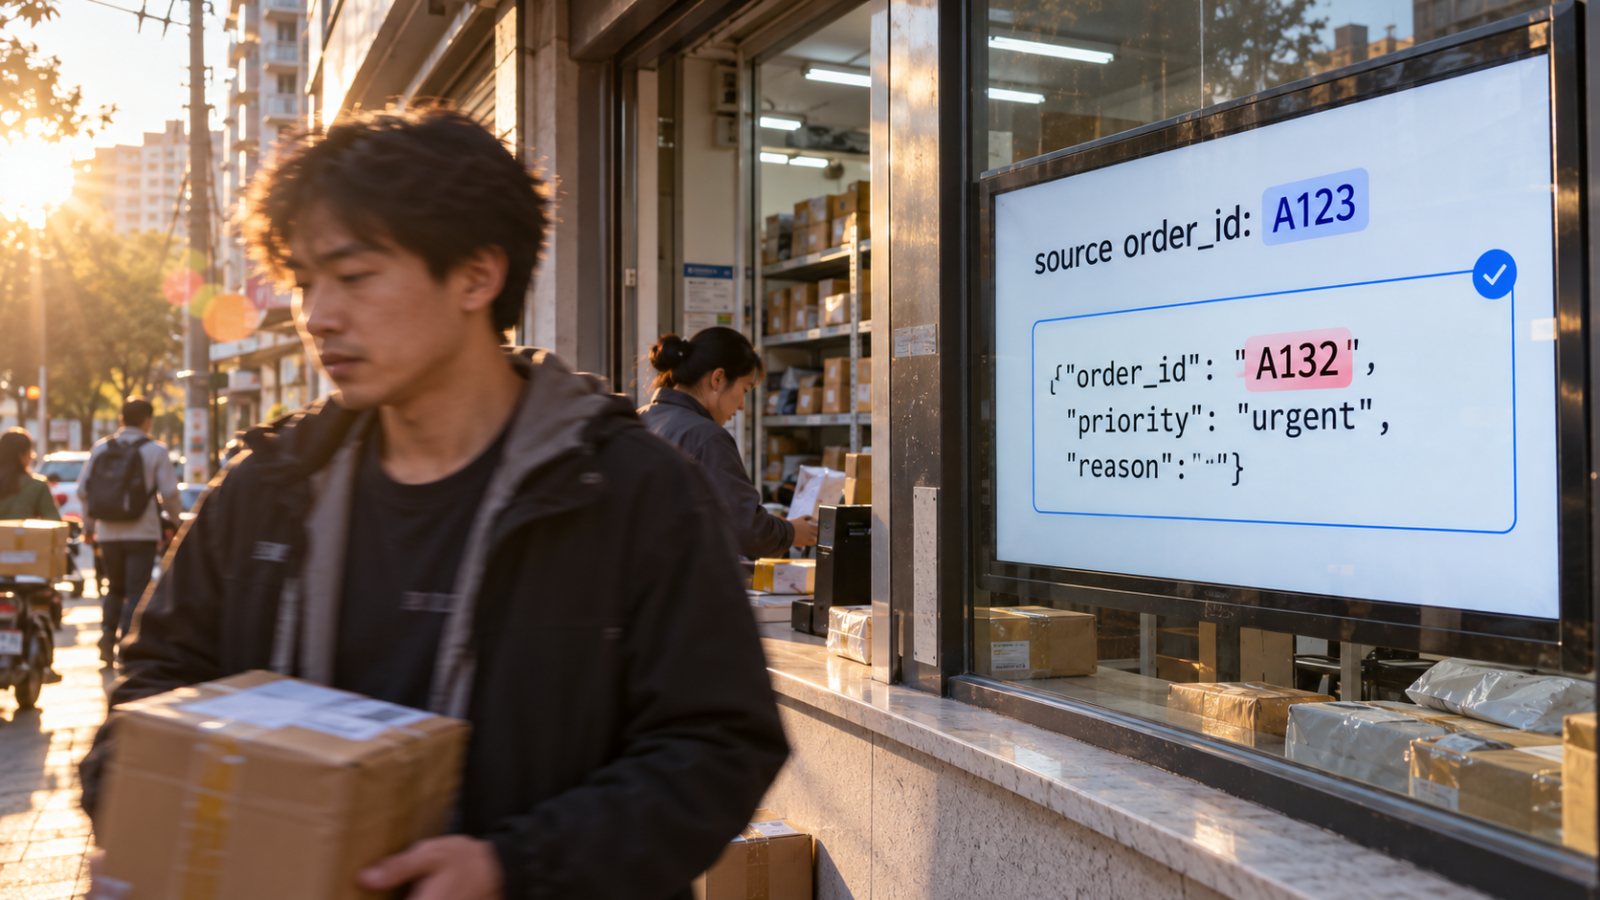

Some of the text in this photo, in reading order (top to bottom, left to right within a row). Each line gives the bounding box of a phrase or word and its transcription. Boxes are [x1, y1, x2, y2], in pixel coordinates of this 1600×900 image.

[1034, 183, 1357, 276] source order_id: A123
[1067, 398, 1390, 440] "priority": "urgent",
